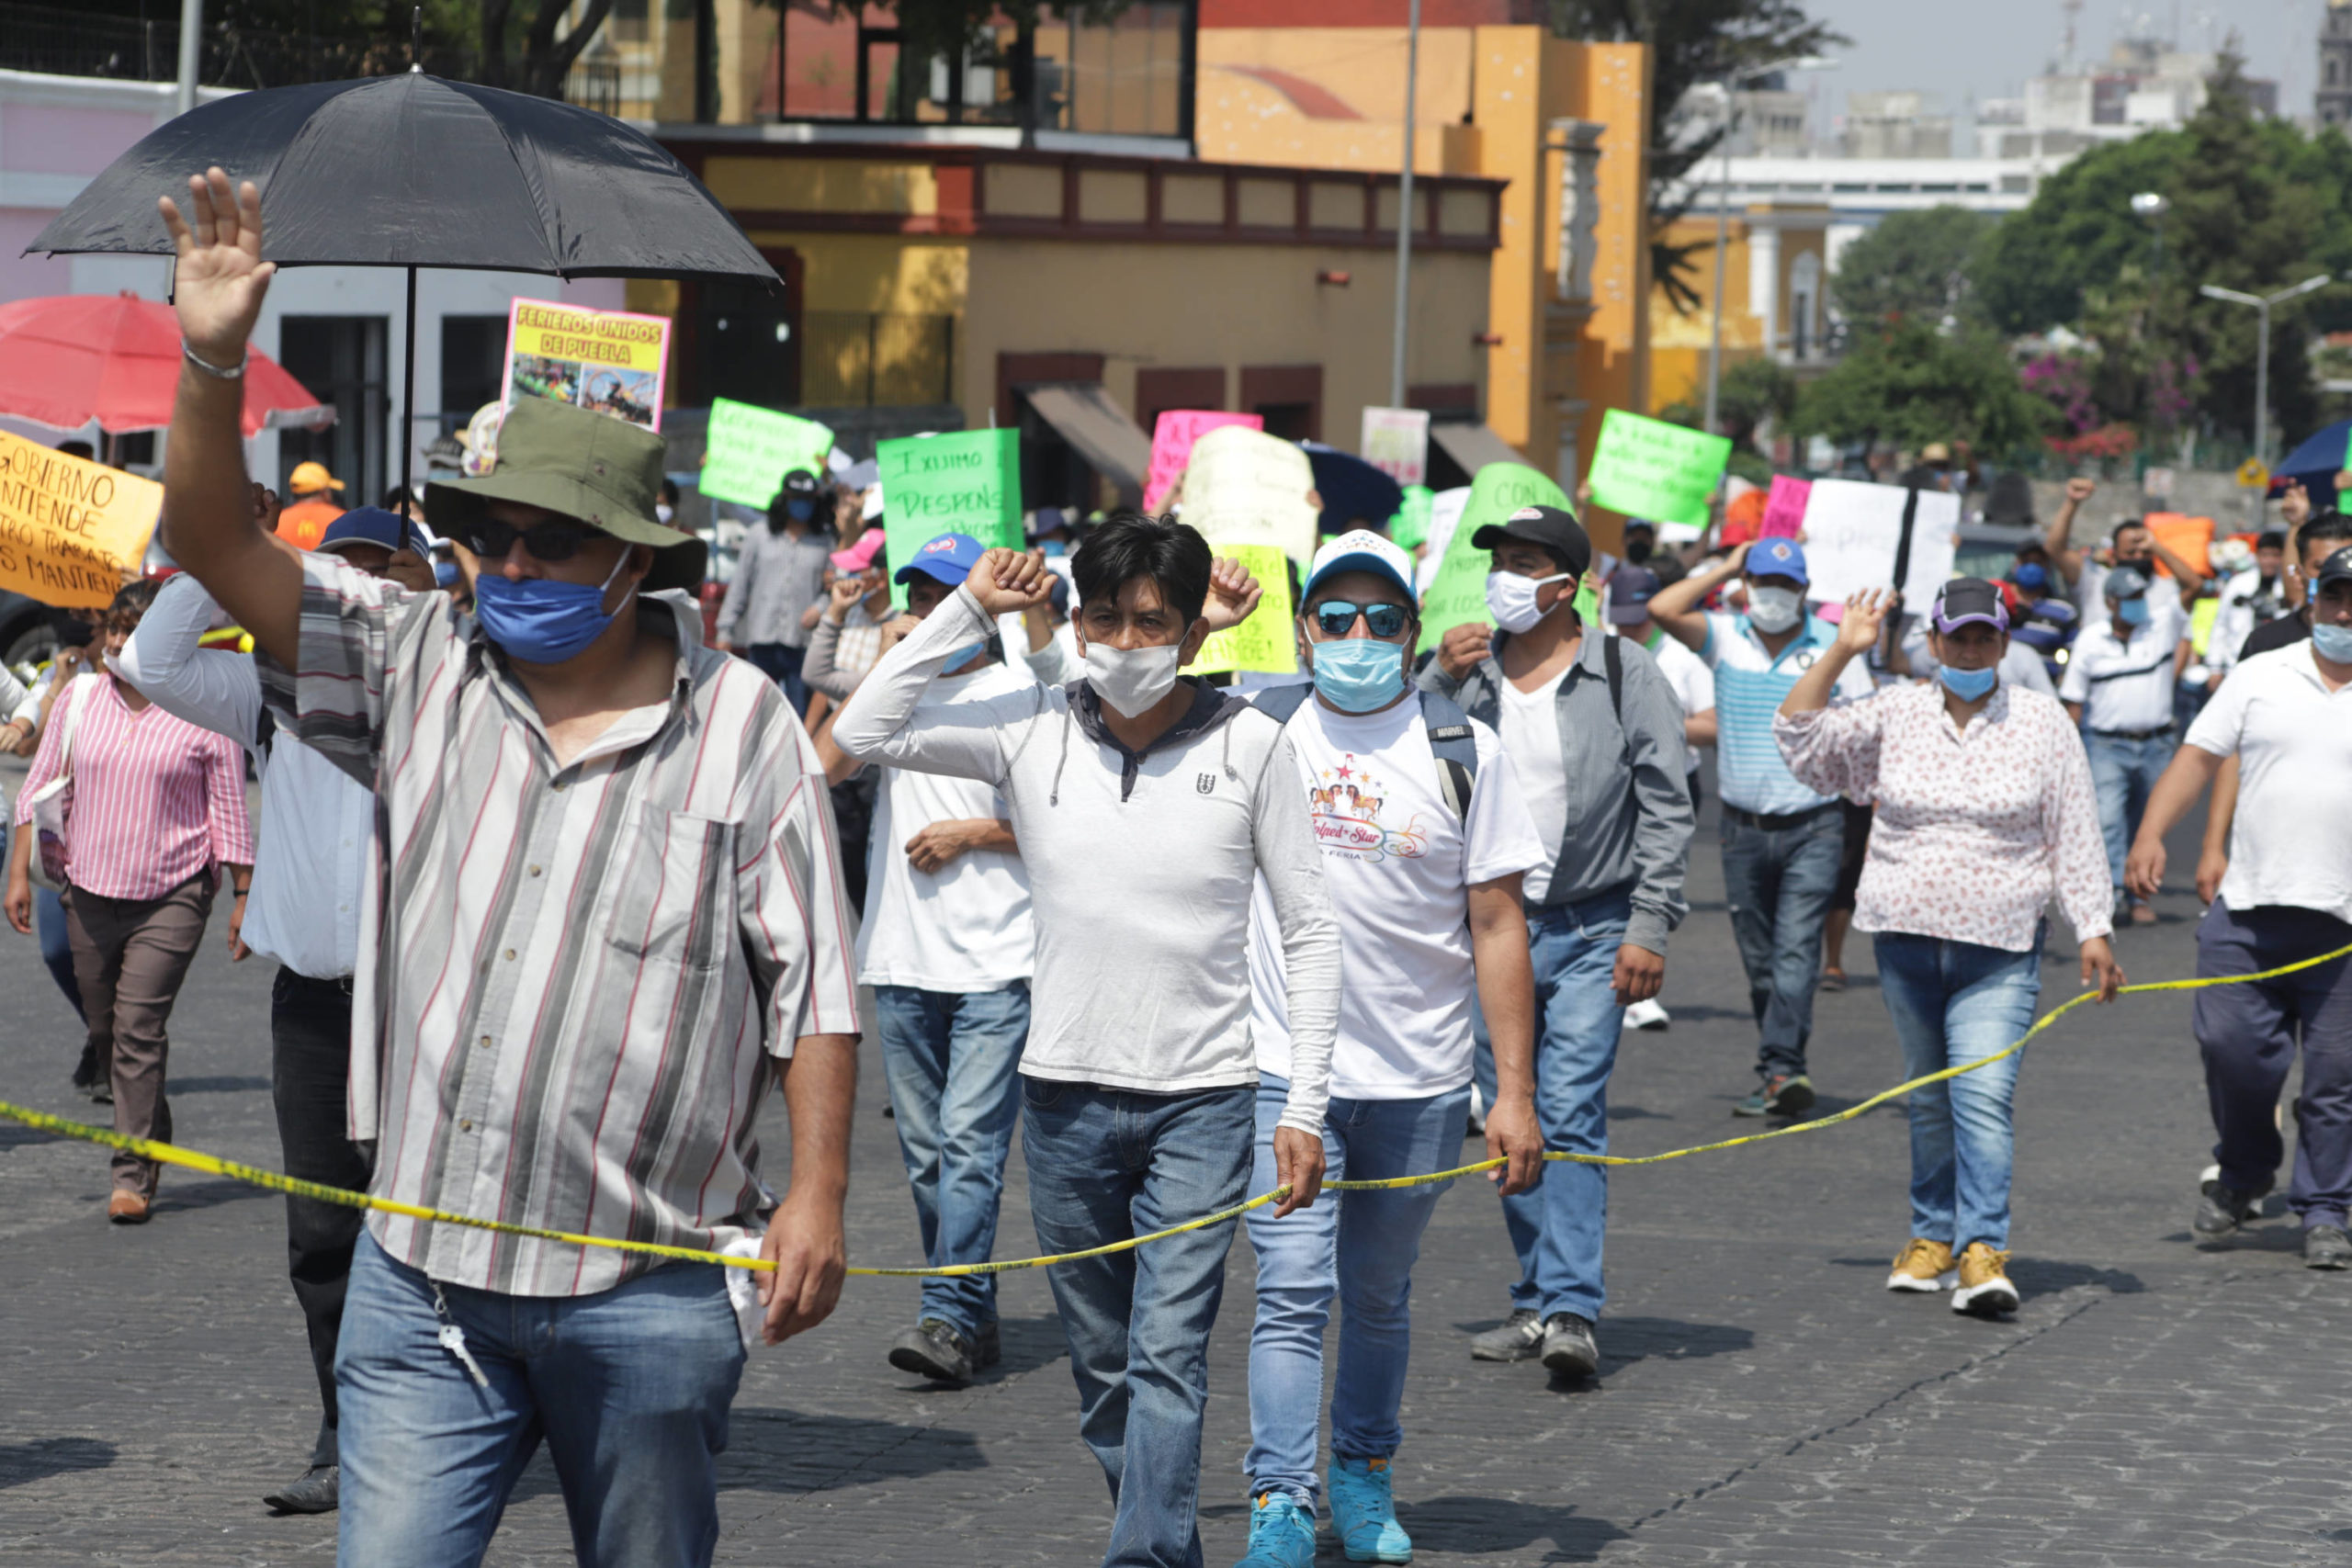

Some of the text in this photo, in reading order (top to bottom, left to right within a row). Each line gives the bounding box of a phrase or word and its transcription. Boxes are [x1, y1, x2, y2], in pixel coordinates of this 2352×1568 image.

[518, 305, 662, 344] FERIEROS UNIDOS
[540, 333, 631, 365] DE PUEBLA
[1437, 725, 1464, 739] MARVEL
[1350, 826, 1380, 843] Star
